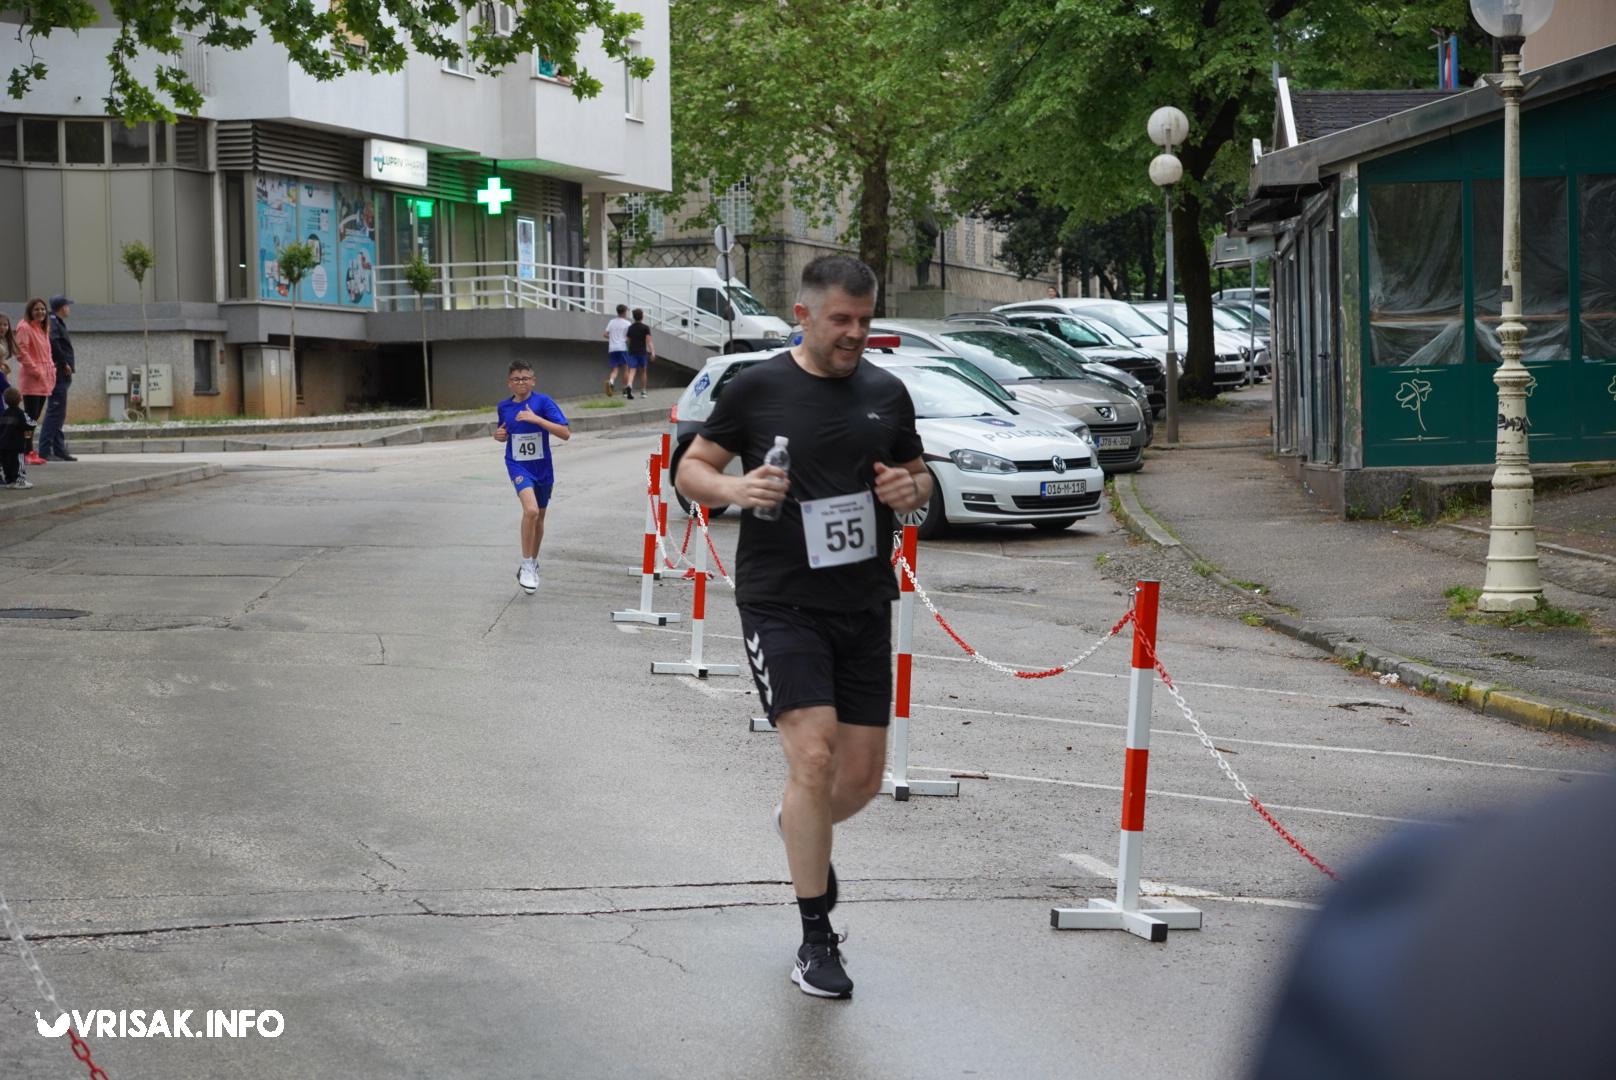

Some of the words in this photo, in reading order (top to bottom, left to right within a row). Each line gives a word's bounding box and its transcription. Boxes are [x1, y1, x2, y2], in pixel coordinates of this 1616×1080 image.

[982, 430, 1071, 442] POLICIJA
[519, 442, 536, 456] 49
[1047, 482, 1085, 495] 016-M-118
[825, 517, 864, 553] 55
